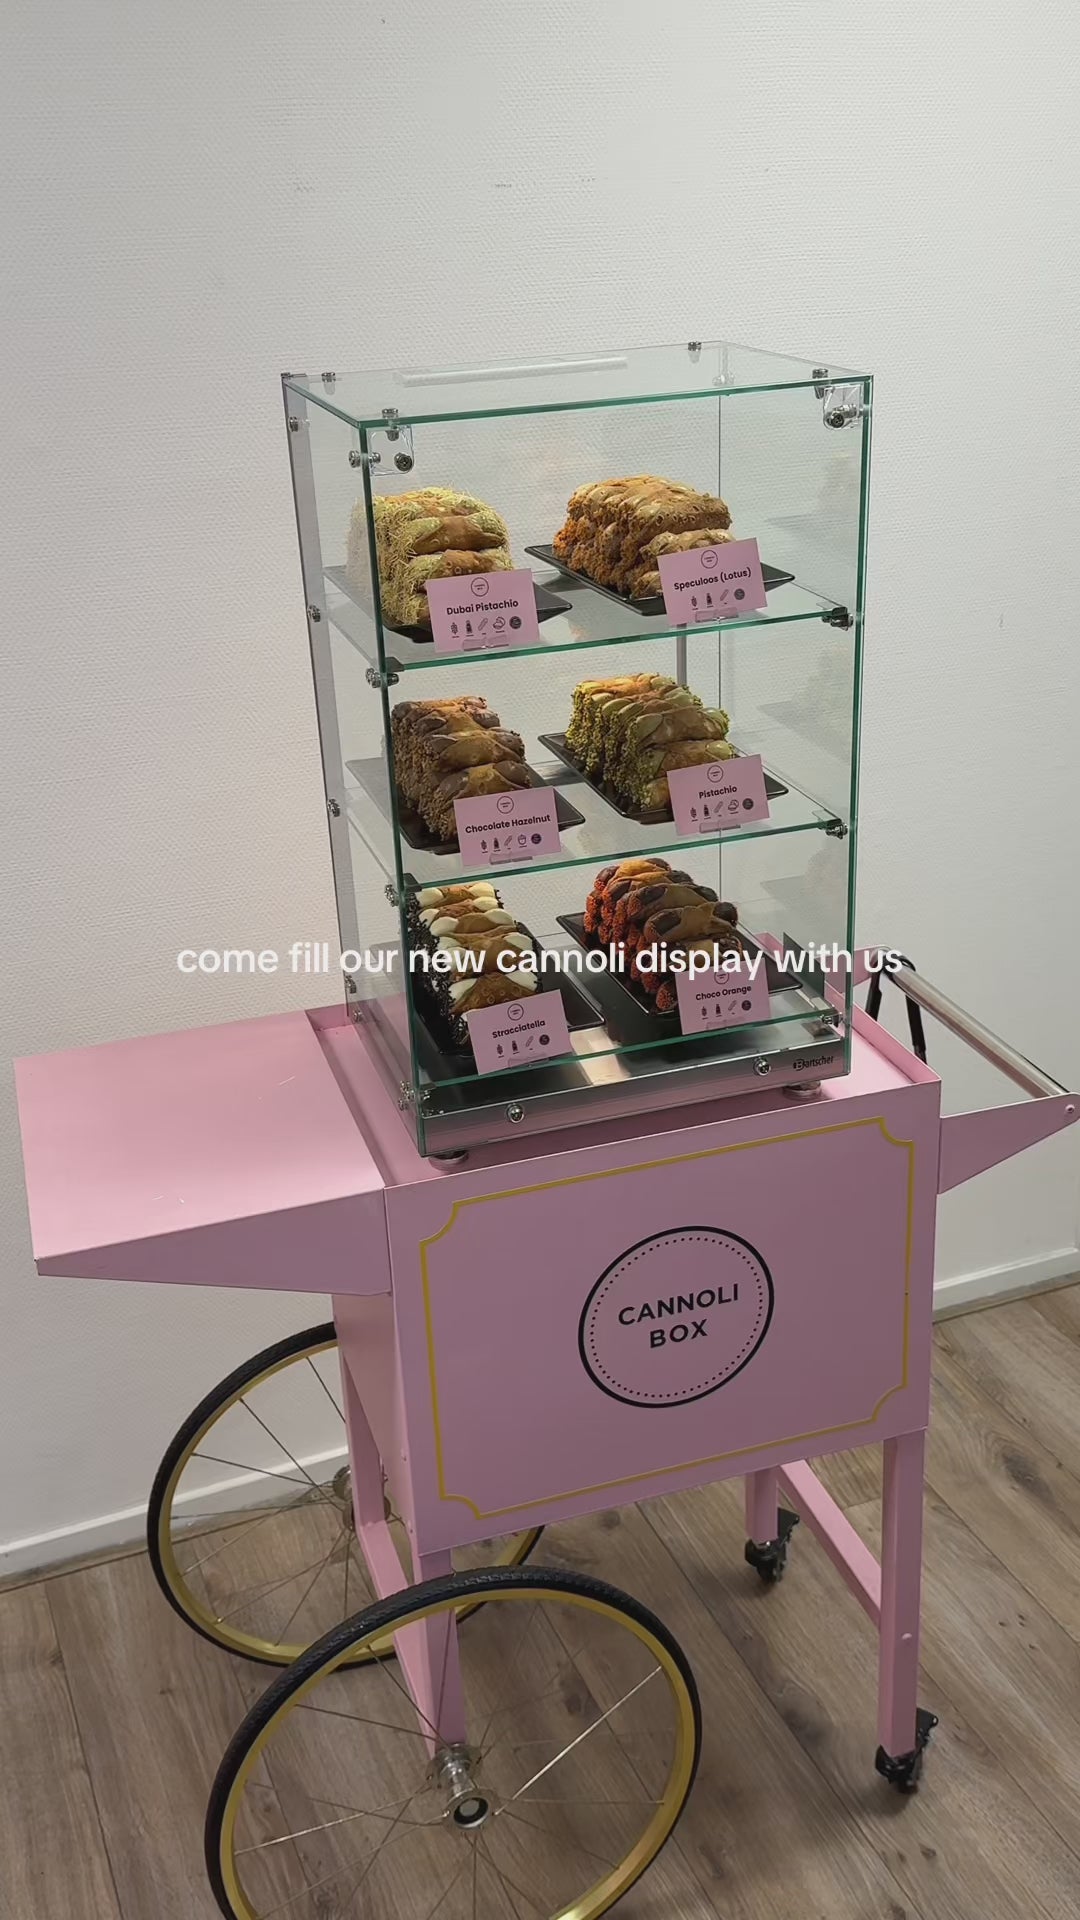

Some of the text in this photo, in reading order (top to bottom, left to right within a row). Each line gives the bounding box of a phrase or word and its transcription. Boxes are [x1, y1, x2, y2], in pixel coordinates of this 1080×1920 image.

[674, 567, 752, 592] Speculoos (Lotus)
[446, 599, 519, 616] Dubai Pistachio
[698, 785, 738, 799] Pistachio
[465, 814, 551, 834] Chocolate Hazelnut
[695, 985, 752, 1001] Choco Orange
[492, 1020, 546, 1039] Stracciatella
[618, 1283, 739, 1325] CANNOLI
[650, 1318, 708, 1348] BOX
